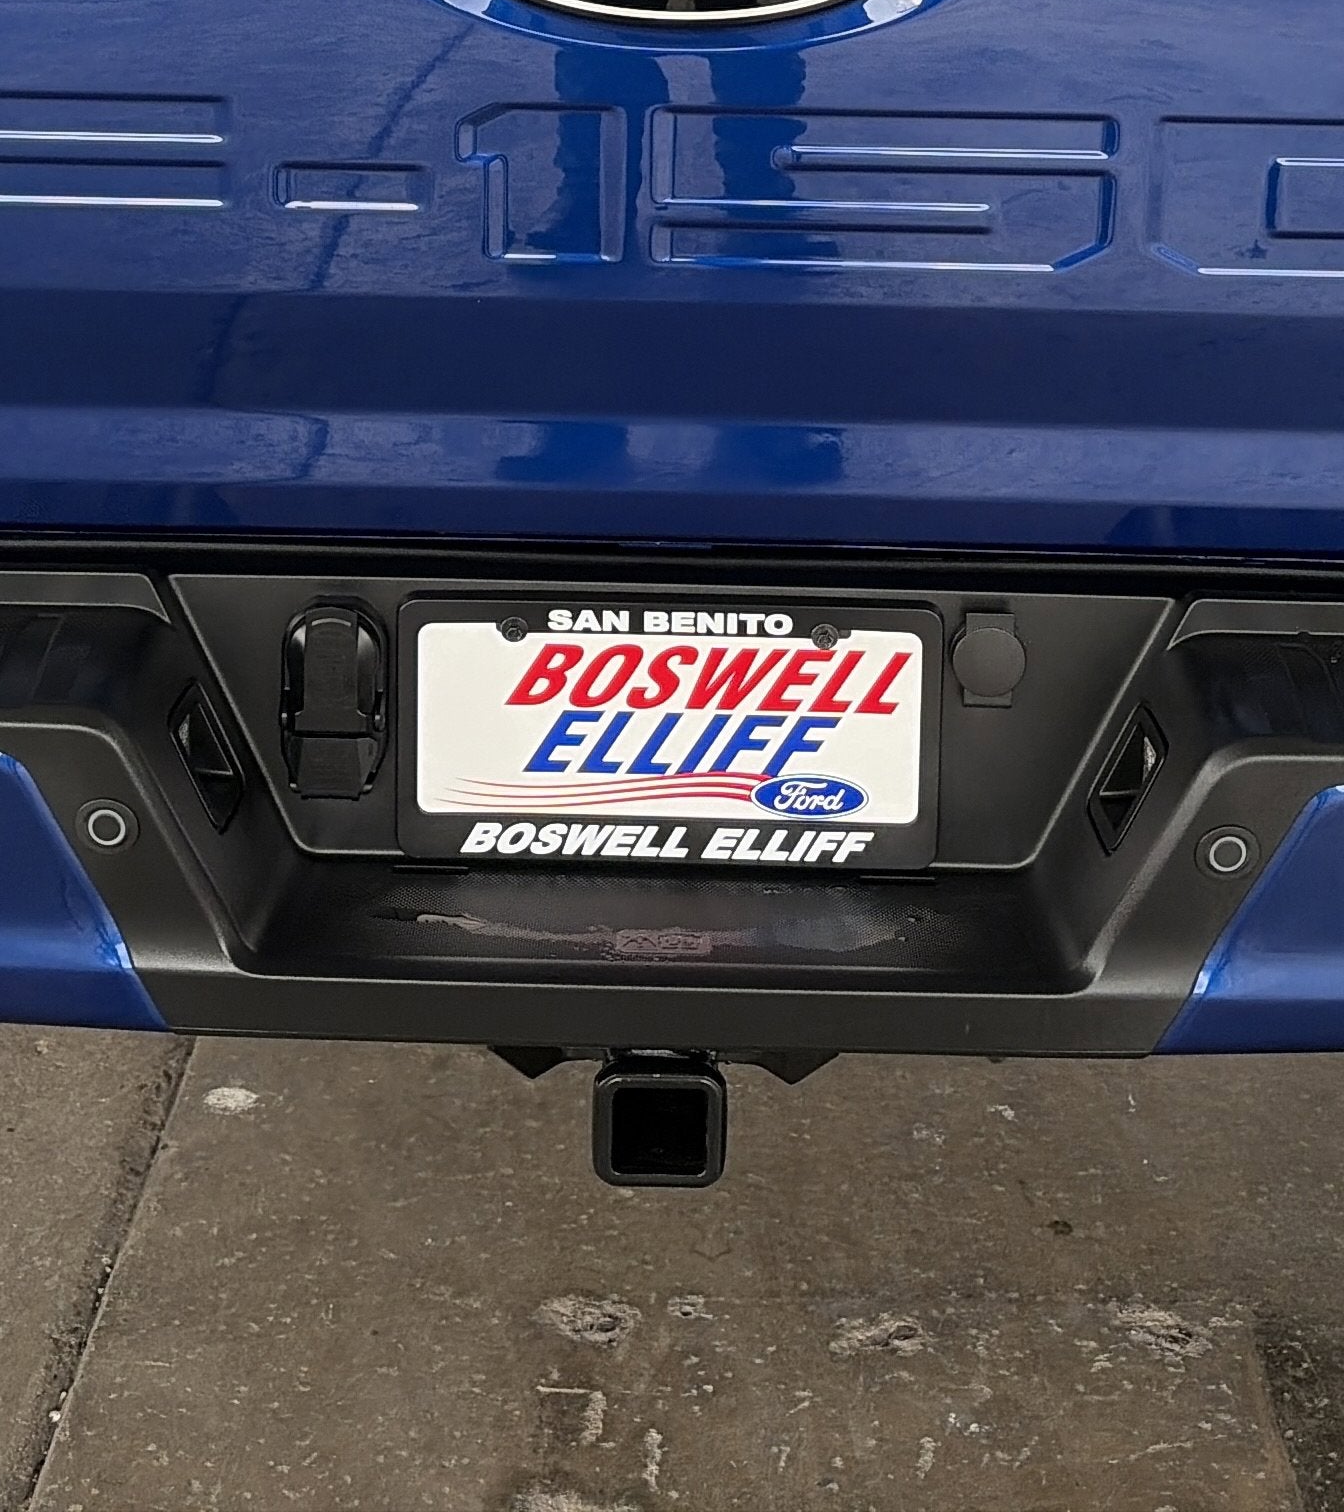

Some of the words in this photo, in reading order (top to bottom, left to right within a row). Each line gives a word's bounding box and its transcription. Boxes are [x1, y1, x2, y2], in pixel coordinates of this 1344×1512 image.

[547, 609, 630, 633] SAN
[644, 611, 793, 637] BENITO
[505, 643, 913, 715] BOSWELL
[522, 710, 843, 777] ELLIFF
[773, 780, 845, 813] Ford
[459, 822, 689, 859] BOSWELL
[700, 829, 874, 863] ELLIFF
